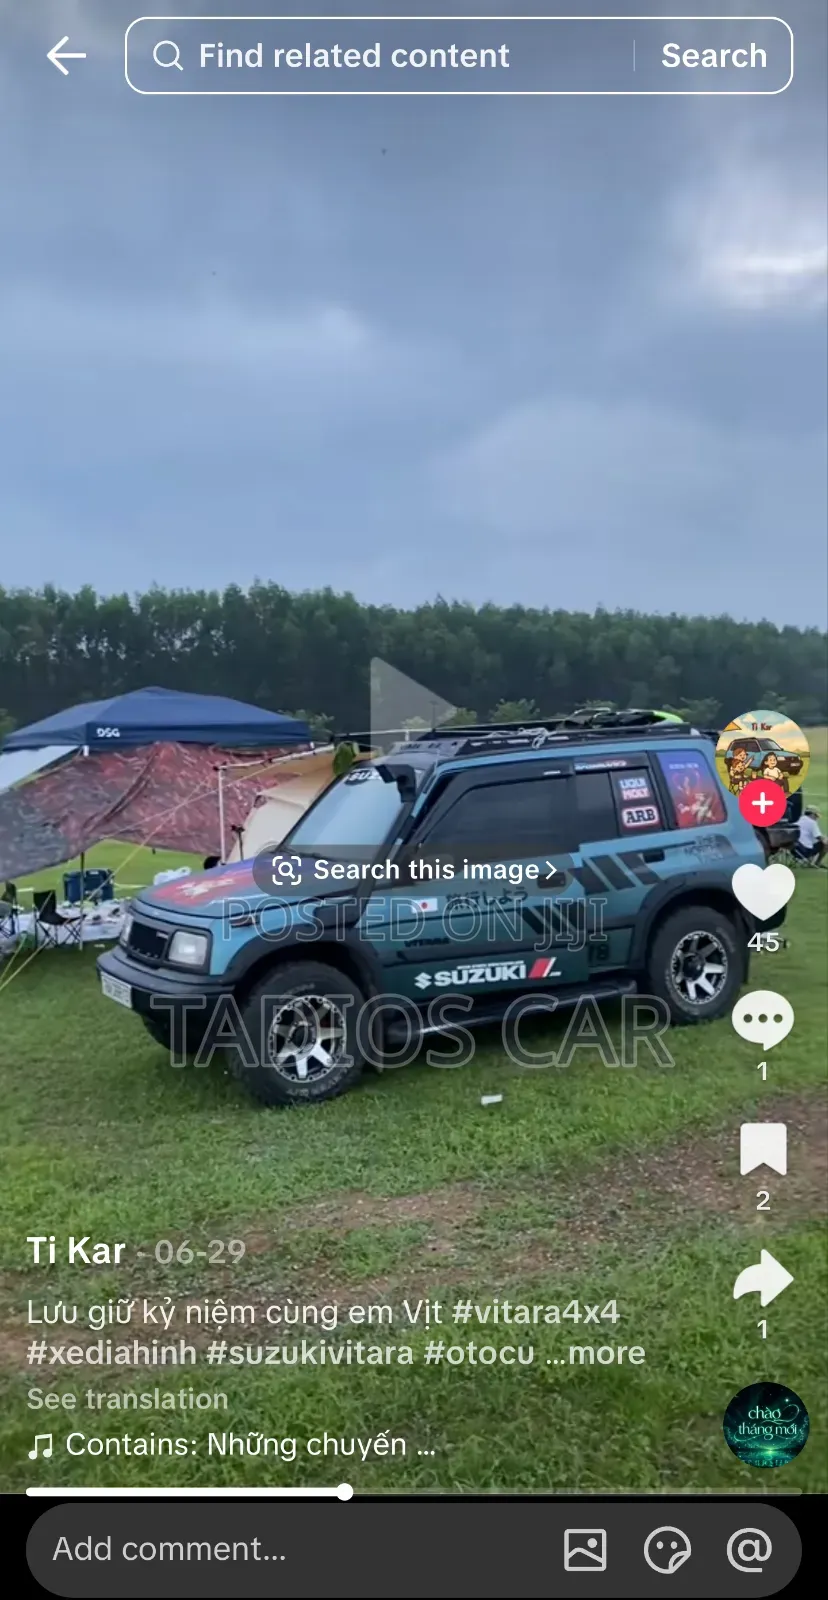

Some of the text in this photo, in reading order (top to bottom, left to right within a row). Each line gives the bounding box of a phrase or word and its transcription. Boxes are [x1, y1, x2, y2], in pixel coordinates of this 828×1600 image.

[96, 727, 120, 738] DSG
[626, 809, 656, 824] ARB
[434, 964, 526, 987] SUZUKI
